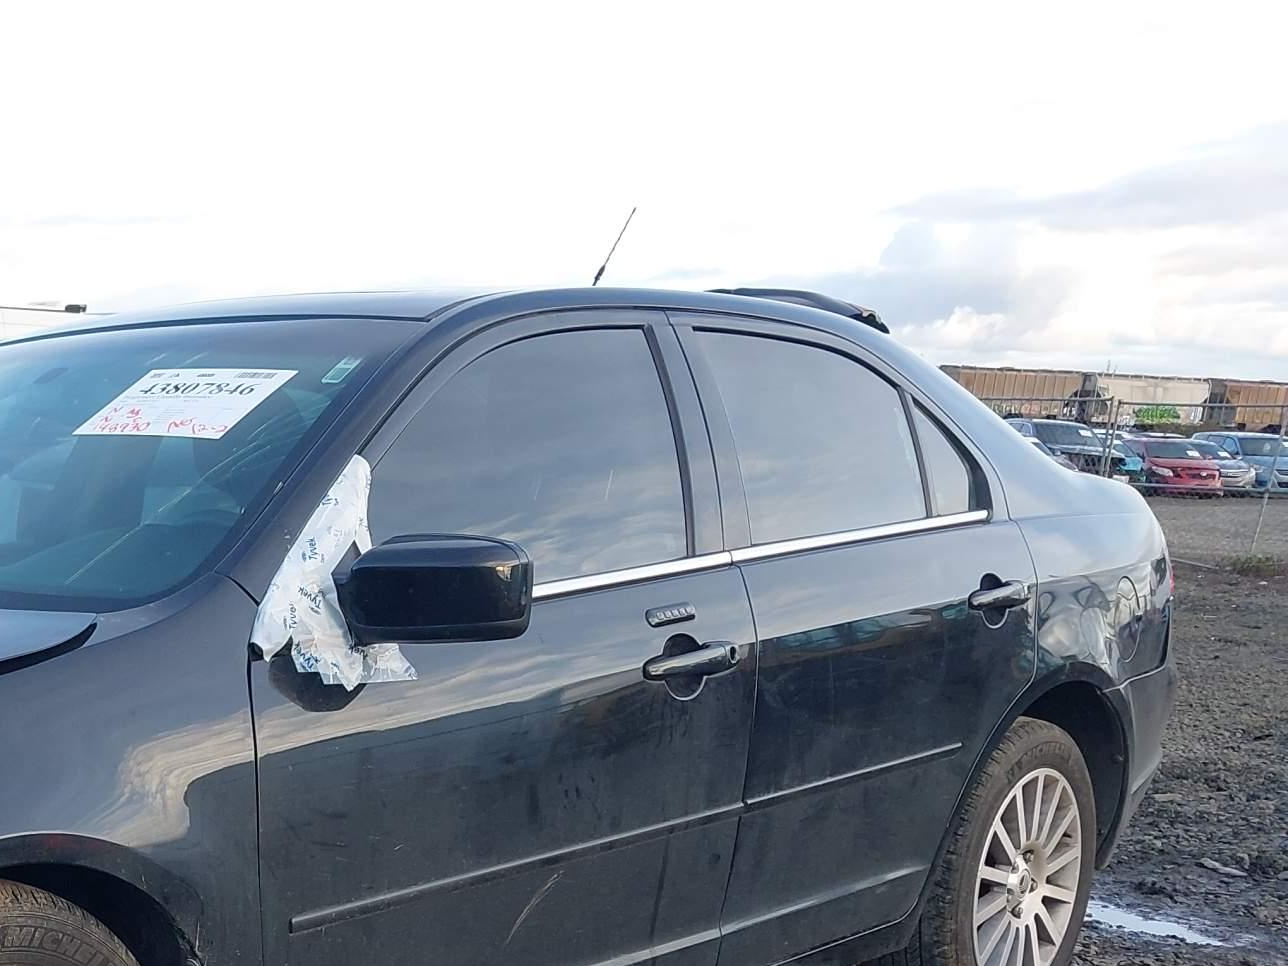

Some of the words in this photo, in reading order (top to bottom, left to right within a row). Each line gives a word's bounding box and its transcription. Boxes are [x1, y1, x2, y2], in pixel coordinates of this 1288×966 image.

[139, 382, 261, 395] 43807846
[306, 536, 318, 560] Tyvek
[298, 586, 322, 609] Tyvek
